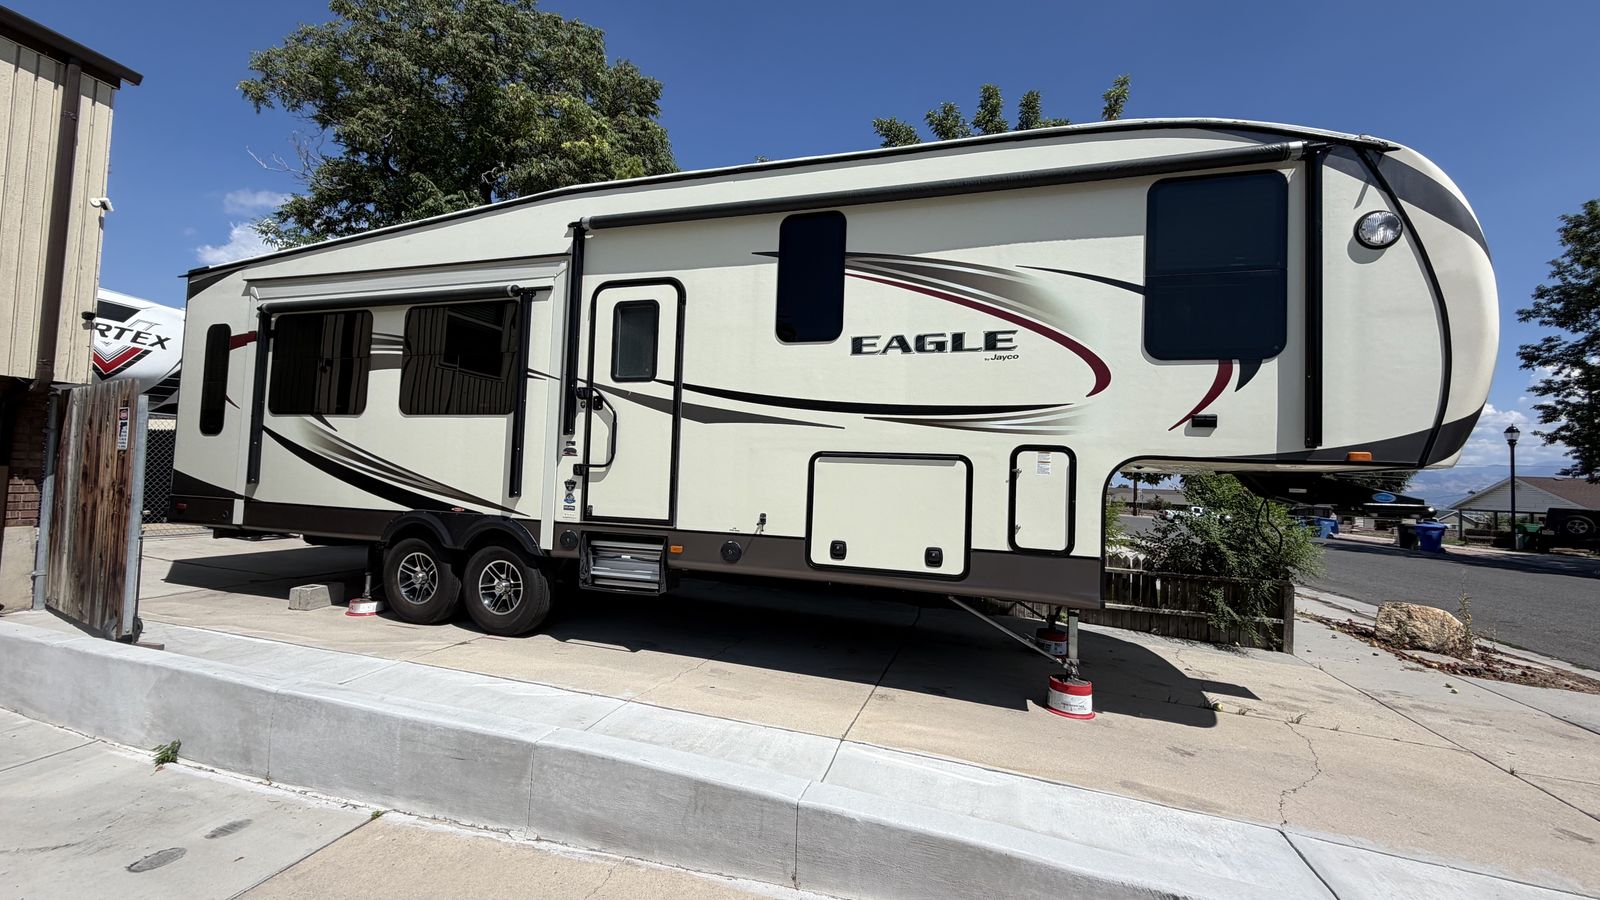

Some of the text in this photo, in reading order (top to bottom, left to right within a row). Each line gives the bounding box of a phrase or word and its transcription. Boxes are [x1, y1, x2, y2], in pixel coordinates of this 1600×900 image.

[95, 322, 171, 350] RTEX
[850, 330, 1018, 356] EAGLE
[990, 353, 1019, 362] Jayco
